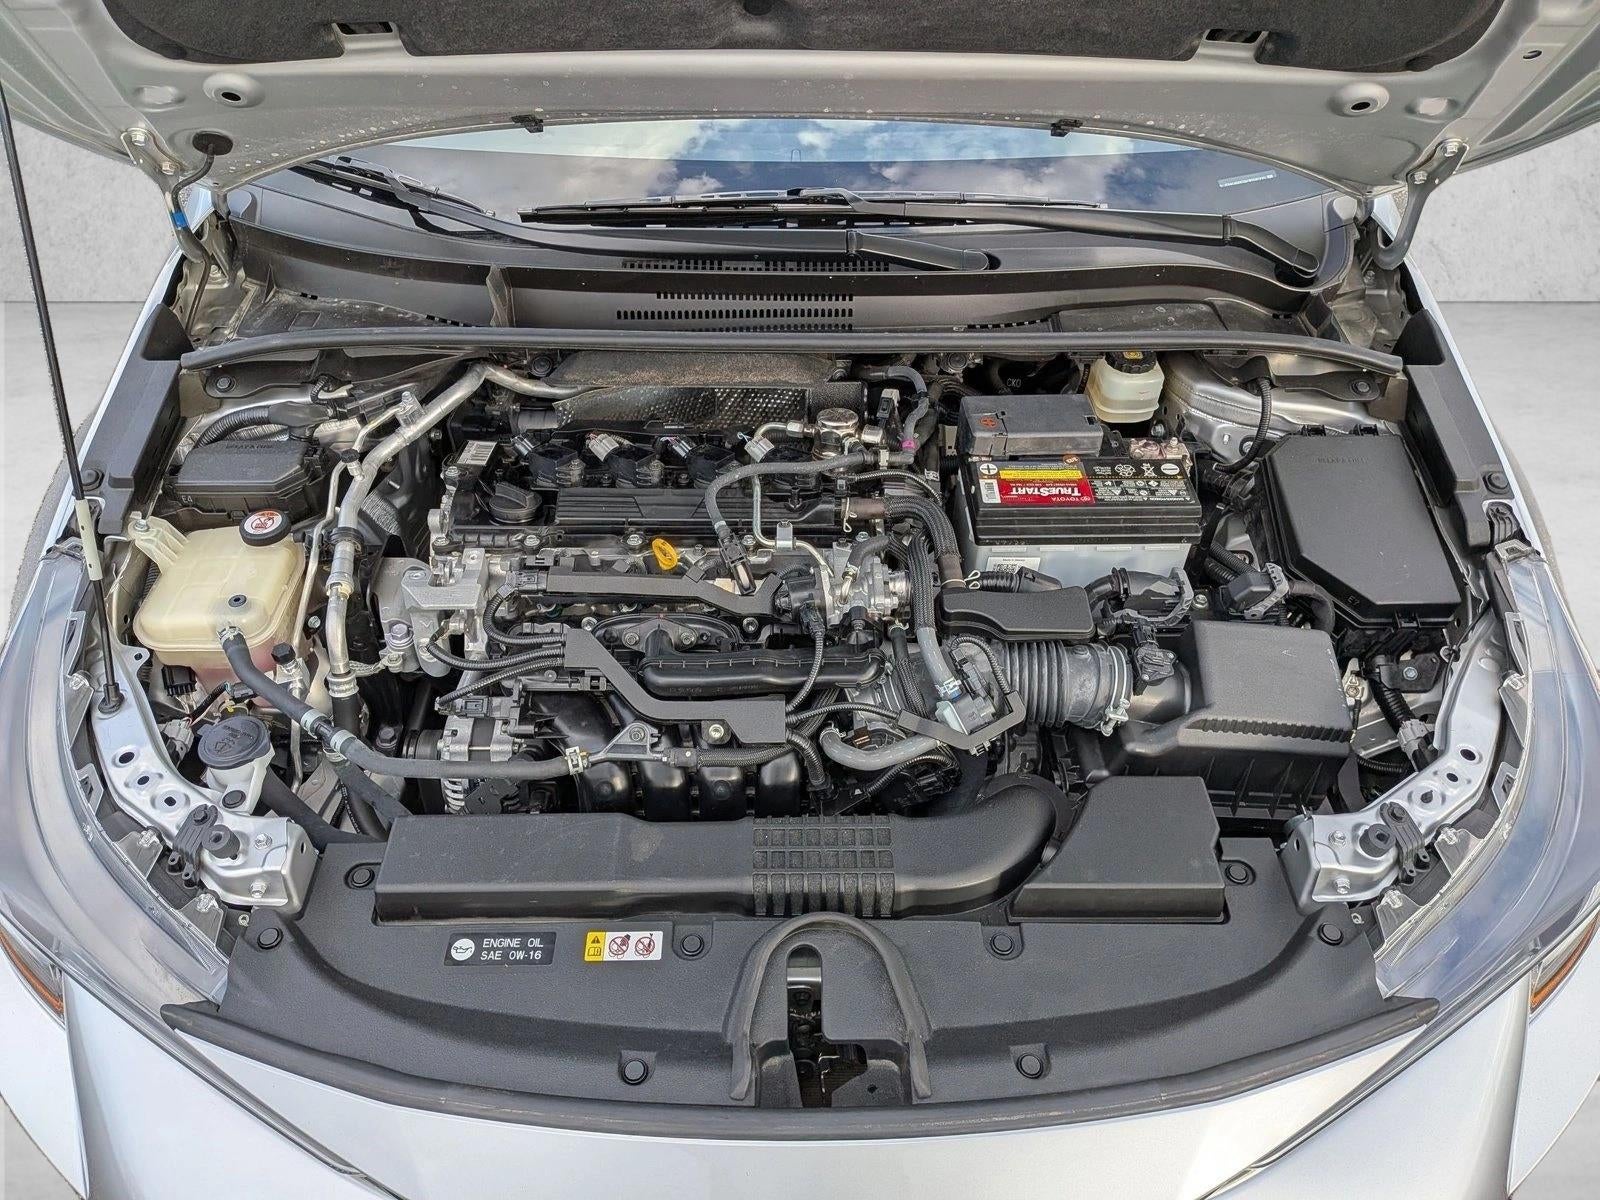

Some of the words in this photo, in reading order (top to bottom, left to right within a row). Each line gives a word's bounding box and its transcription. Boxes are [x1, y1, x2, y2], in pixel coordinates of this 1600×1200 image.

[482, 938, 521, 948] ENGINE
[527, 938, 544, 948] OIL
[480, 951, 501, 960] SAE
